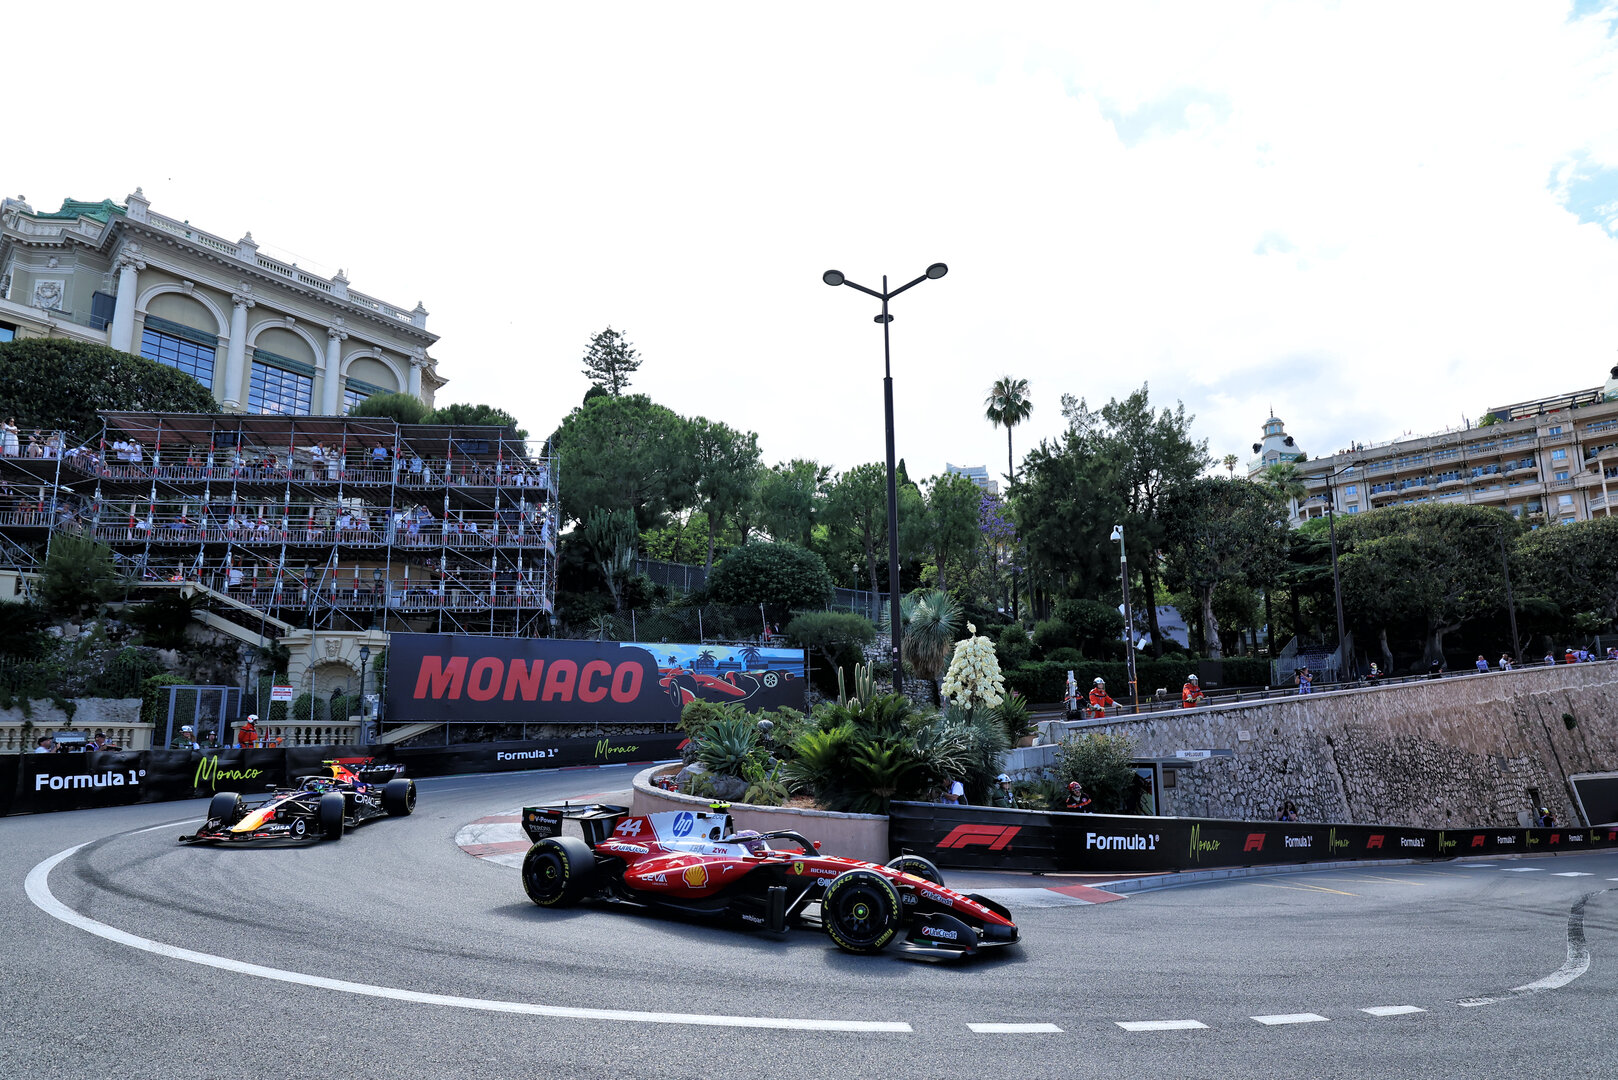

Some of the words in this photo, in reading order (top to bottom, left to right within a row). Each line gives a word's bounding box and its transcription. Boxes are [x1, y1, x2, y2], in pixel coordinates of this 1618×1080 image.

[413, 655, 643, 703] MONACO
[497, 749, 545, 760] Formula
[595, 738, 639, 760] Monaco
[36, 771, 124, 791] Formula
[194, 755, 263, 791] Monaco
[616, 819, 643, 837] 44
[674, 812, 693, 837] hp
[936, 824, 1022, 851] F1
[1086, 832, 1146, 850] Formula
[1190, 823, 1220, 863] Monaco
[1285, 835, 1307, 848] Formula
[1400, 837, 1420, 847] Formula
[712, 847, 728, 855] ZYN
[642, 873, 667, 883] CEVA
[811, 867, 837, 876] RICHARD
[827, 874, 853, 900] ZERO
[903, 894, 917, 903] FIA
[929, 927, 957, 939] UniCredit
